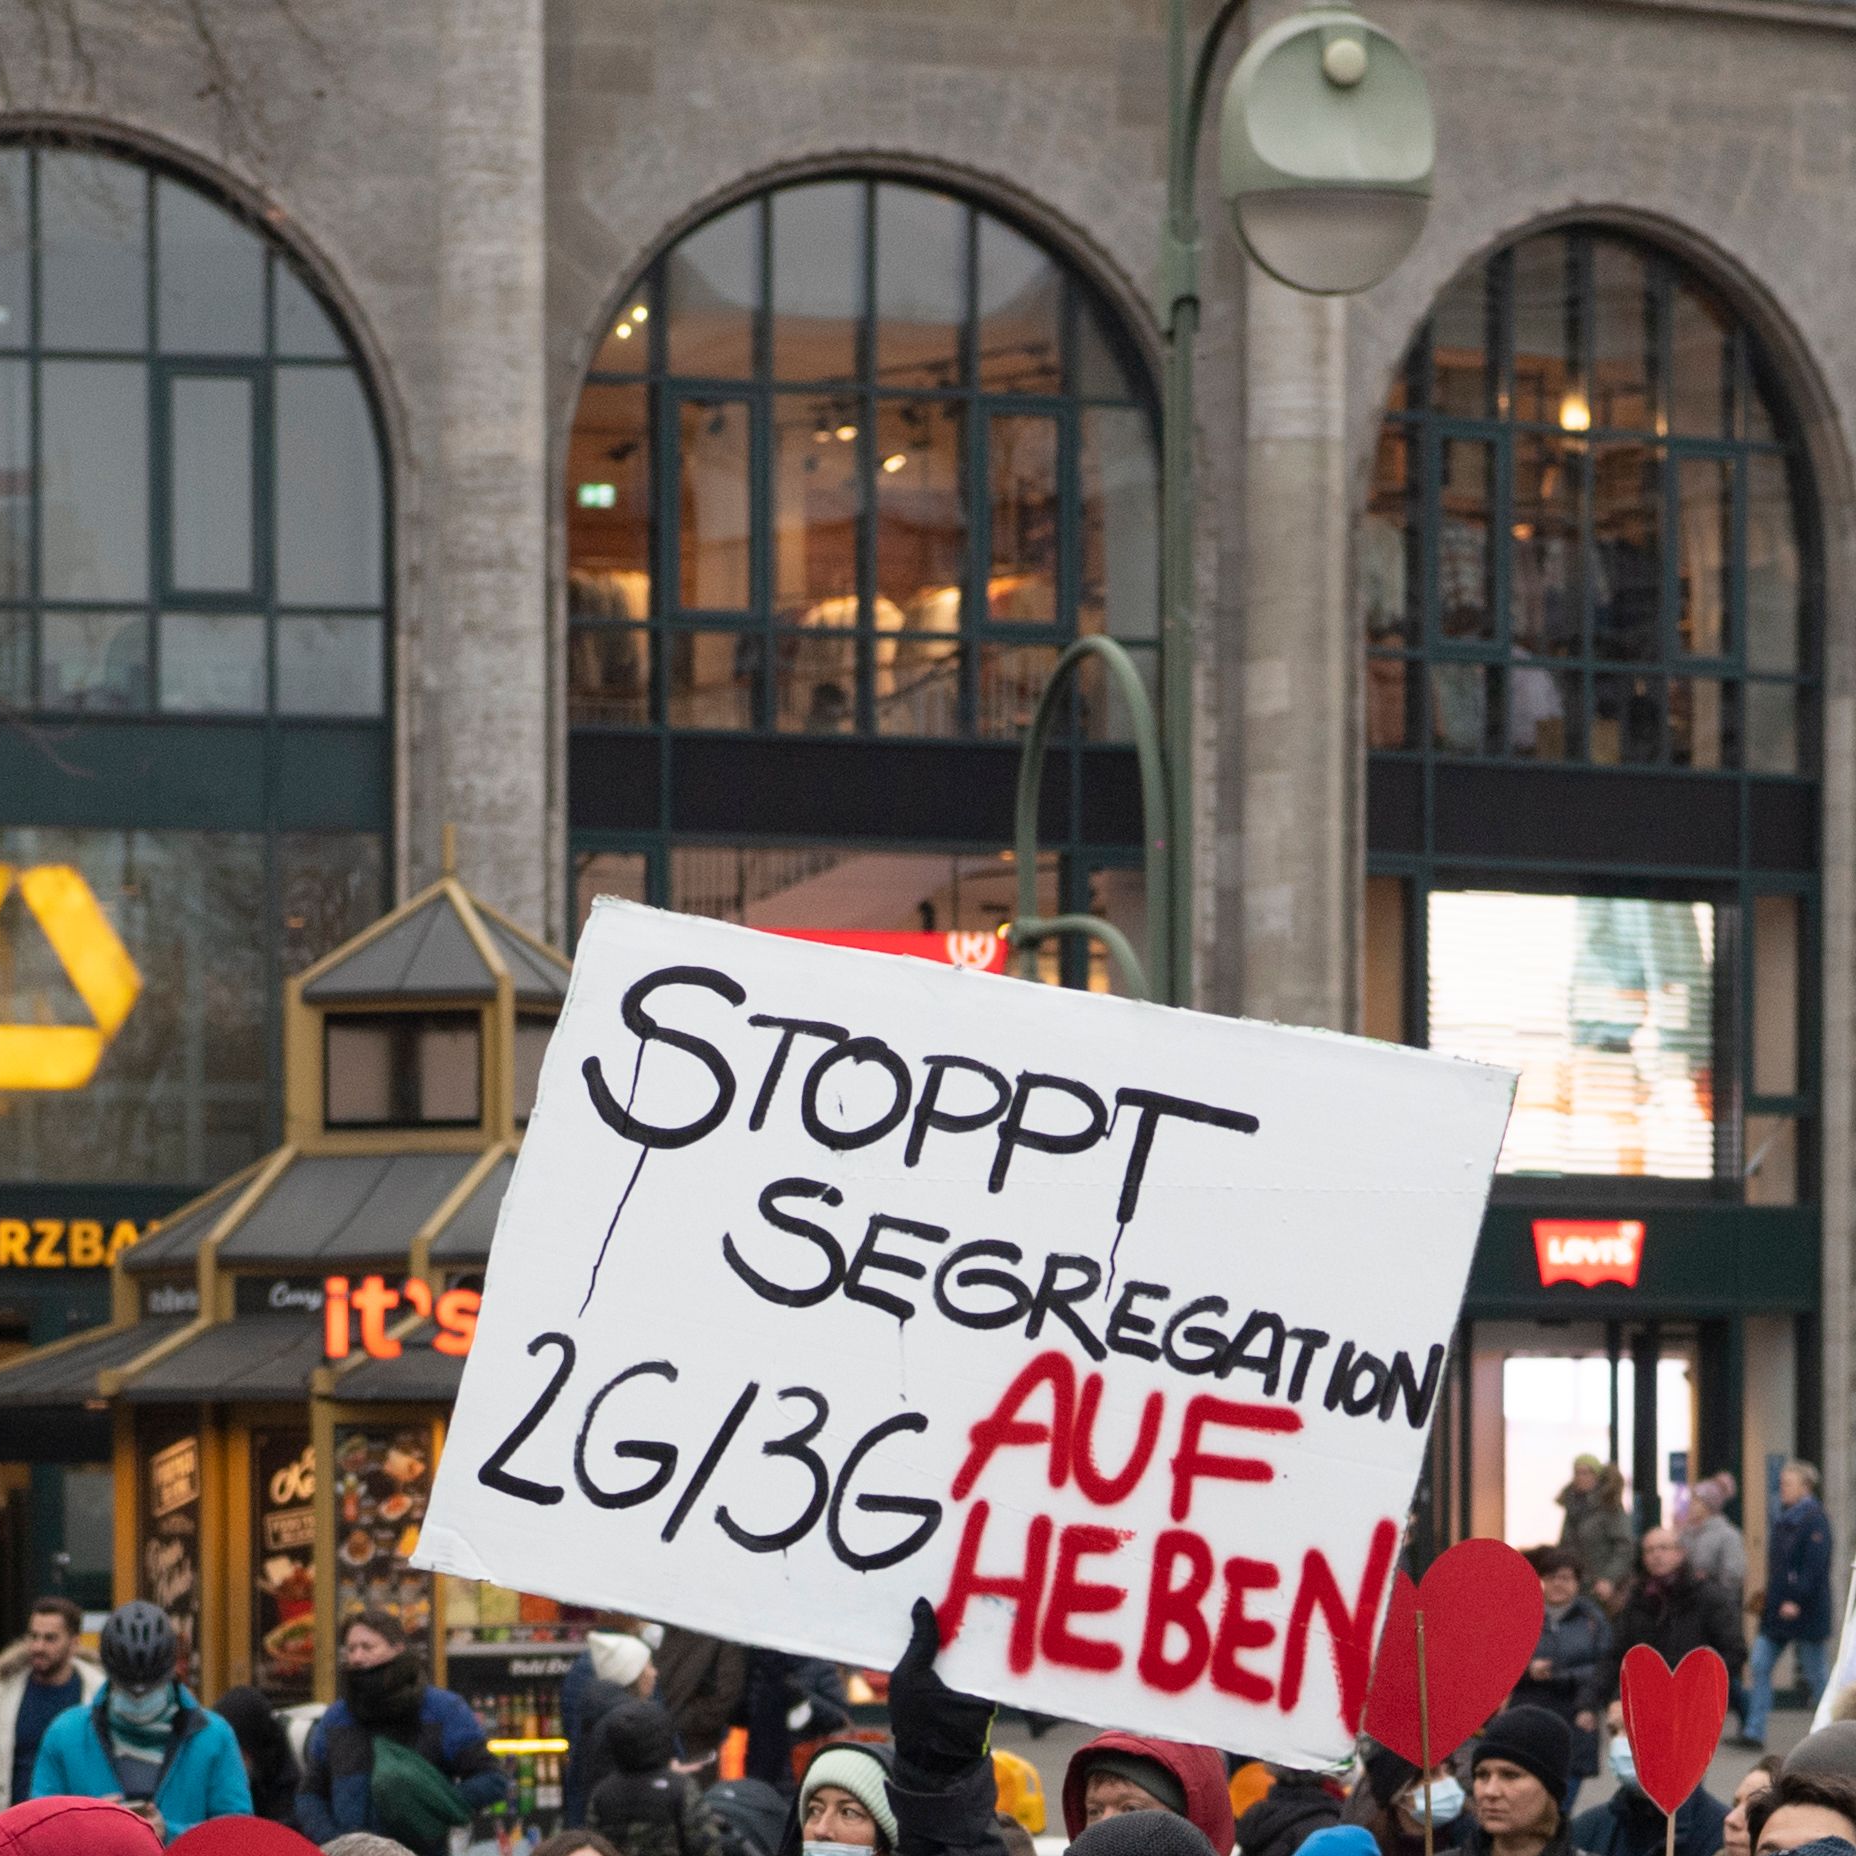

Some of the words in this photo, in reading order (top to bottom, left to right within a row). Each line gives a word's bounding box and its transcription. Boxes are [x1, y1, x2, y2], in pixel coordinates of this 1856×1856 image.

[582, 965, 1261, 1224] STOPPT
[722, 1177, 1446, 1430] SEGREGATION
[475, 1331, 943, 1573] 2G/3G
[951, 1351, 1305, 1523] AUF
[938, 1499, 1399, 1738] HEBEN
